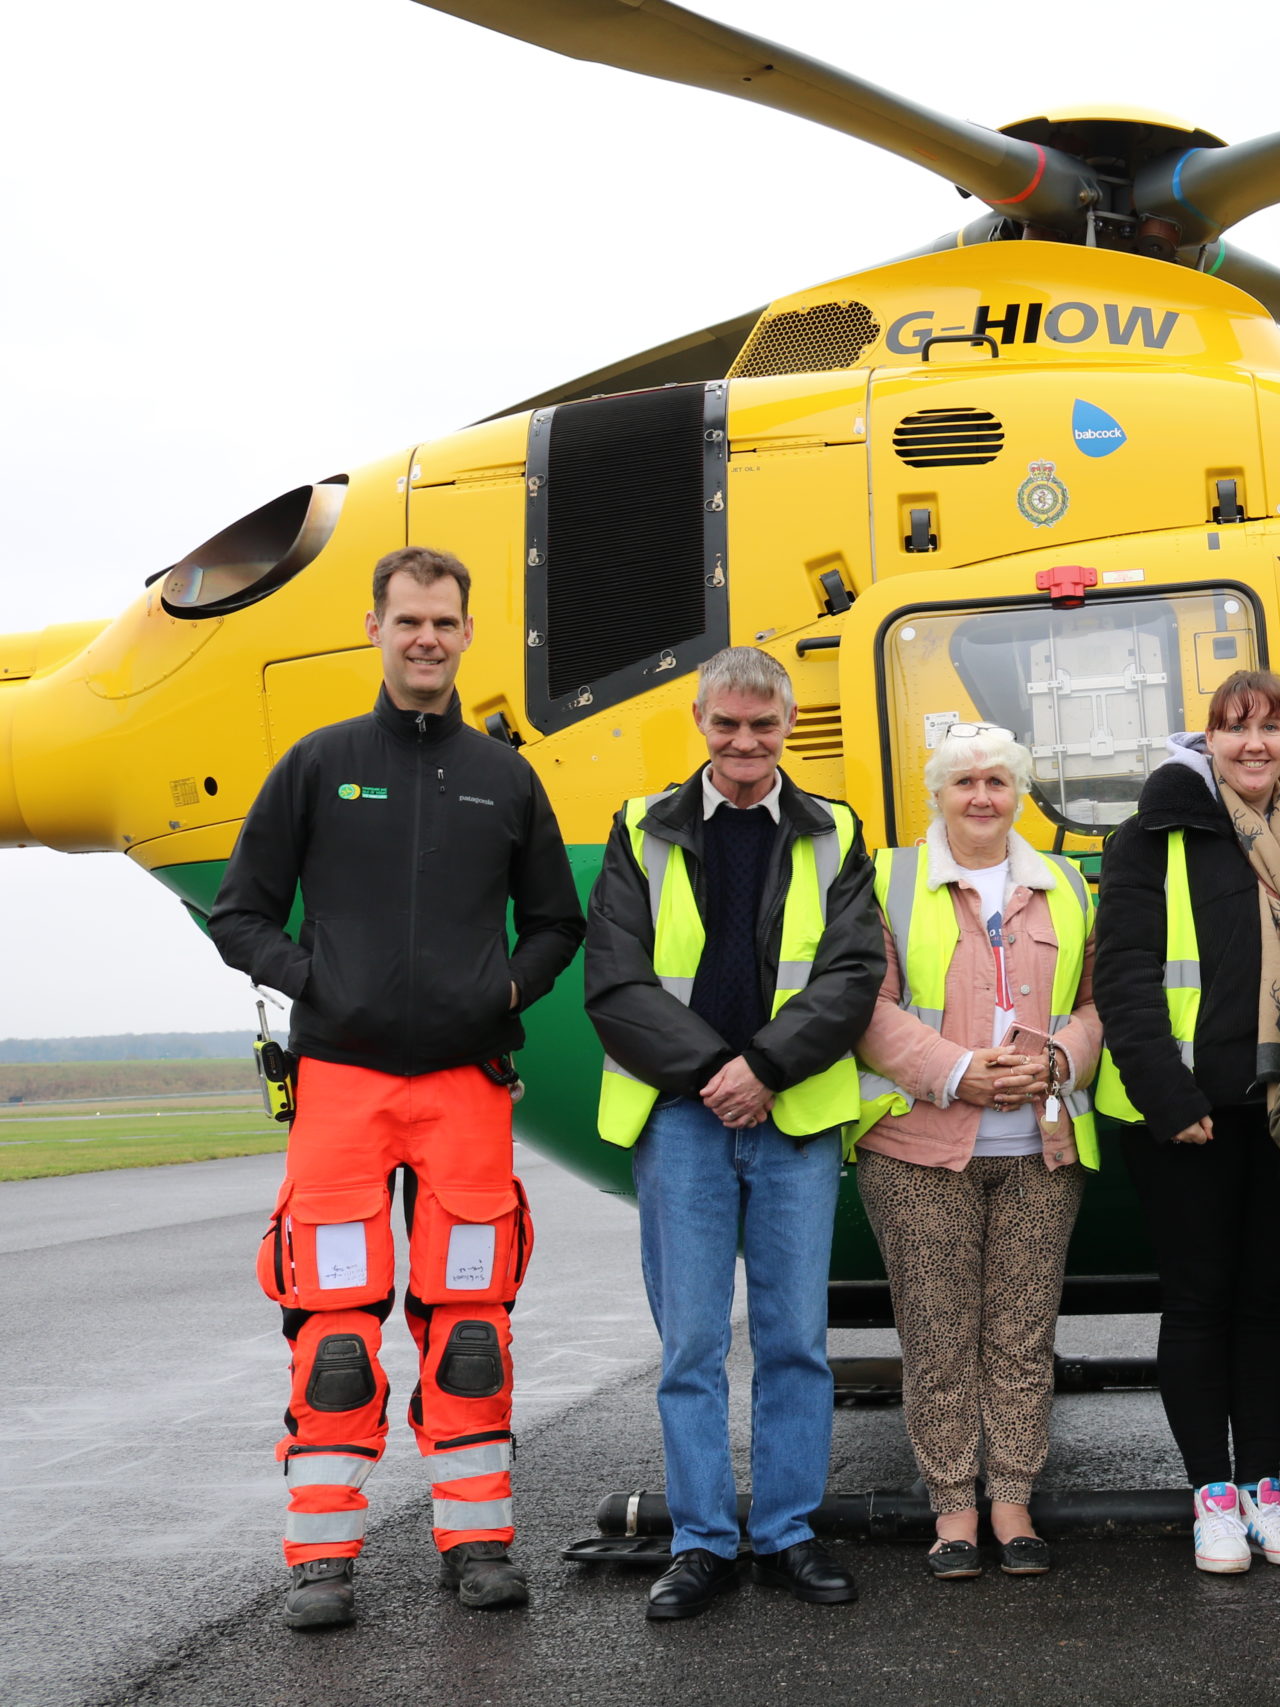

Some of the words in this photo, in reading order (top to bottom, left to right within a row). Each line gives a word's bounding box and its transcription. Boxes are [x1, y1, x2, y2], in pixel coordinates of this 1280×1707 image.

[886, 301, 1180, 354] G-HIOW
[1074, 427, 1123, 440] babcock
[459, 795, 495, 806] patagonia
